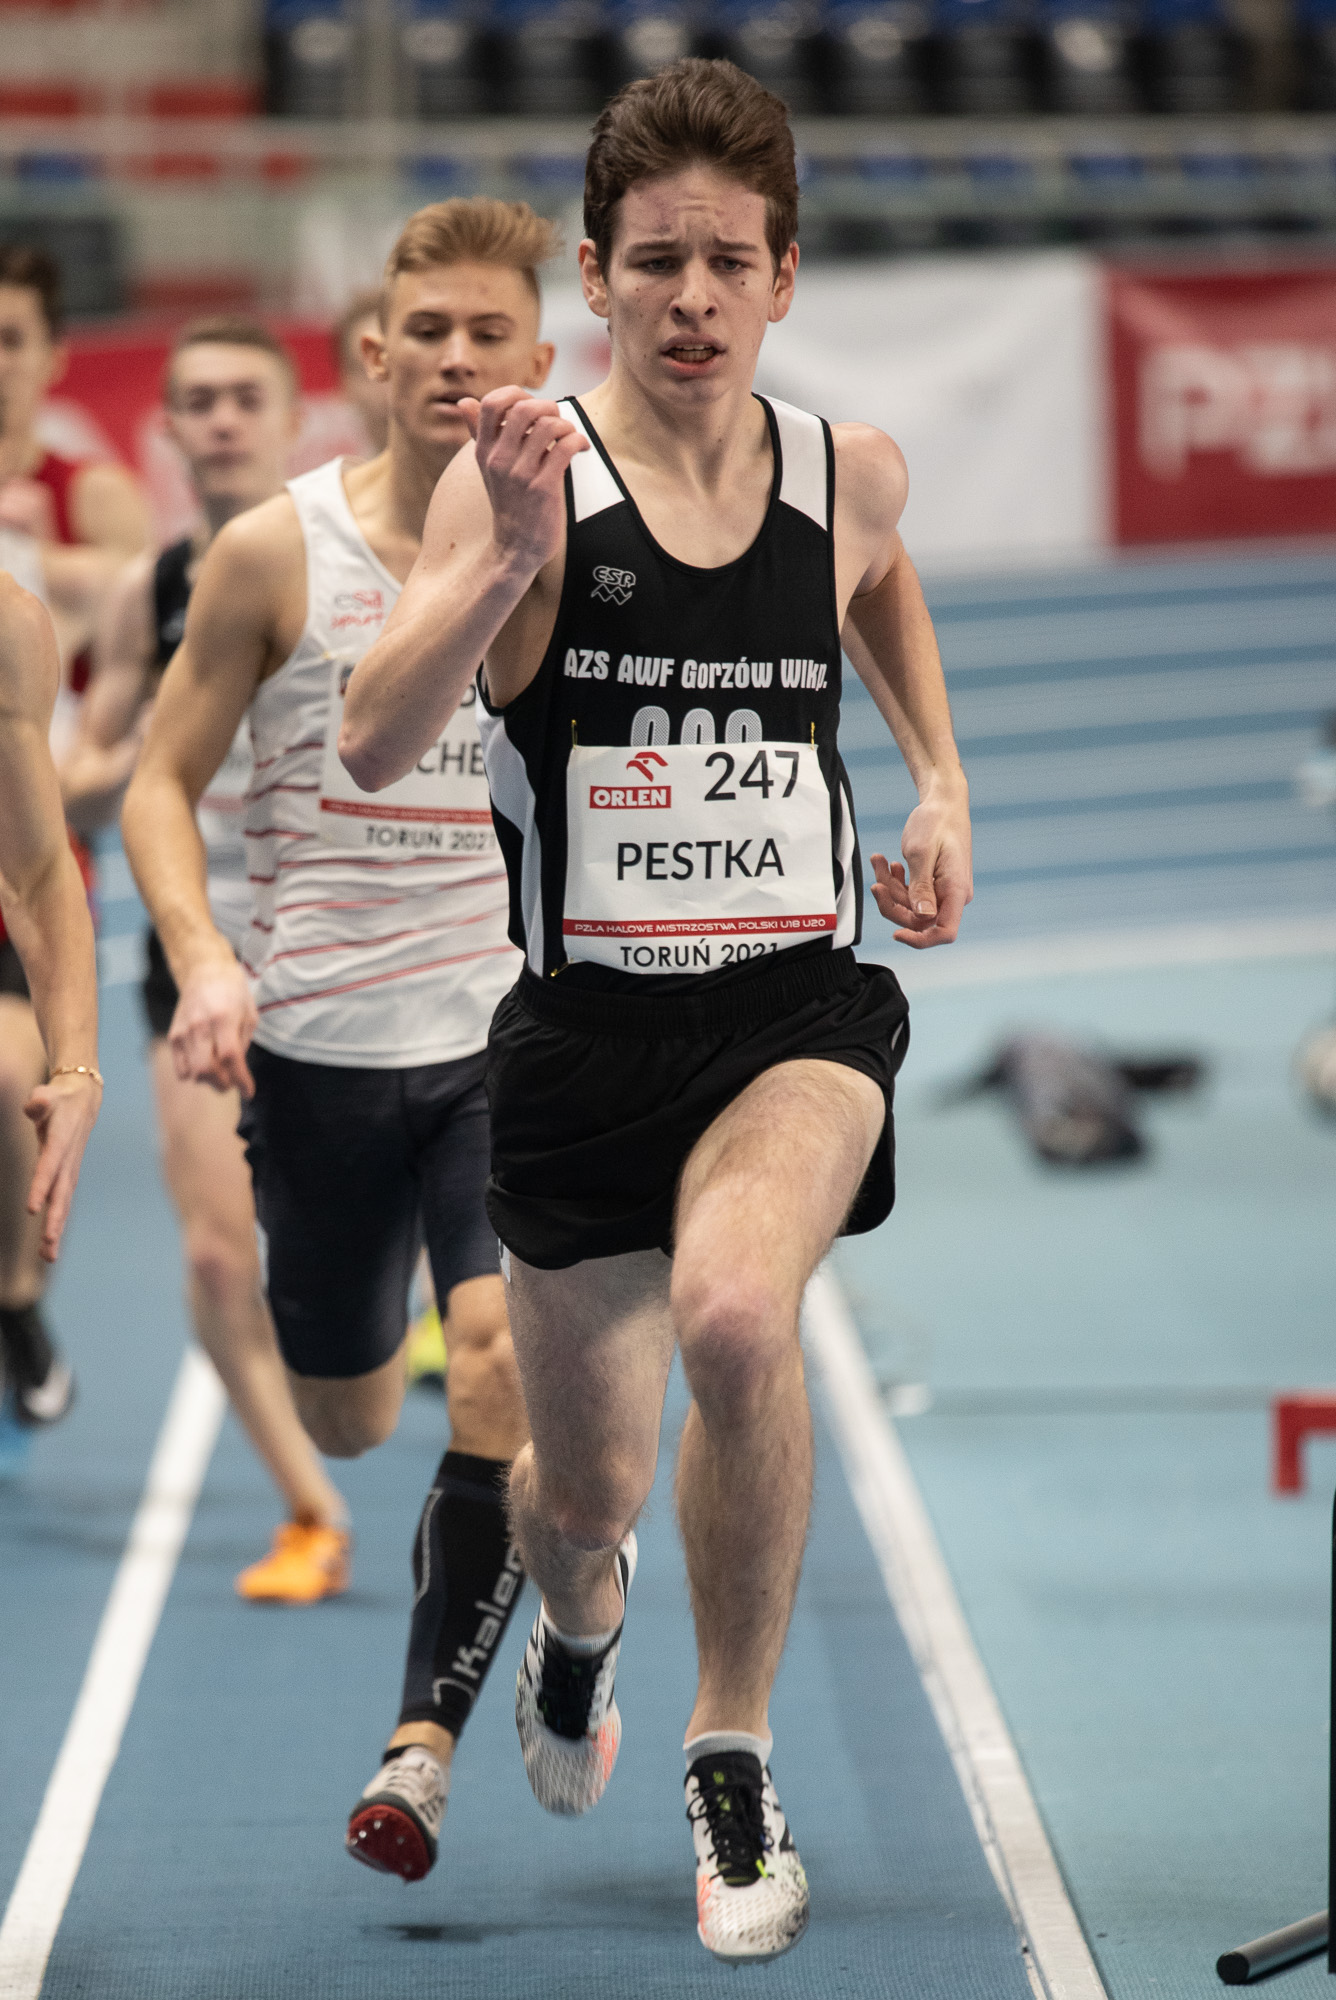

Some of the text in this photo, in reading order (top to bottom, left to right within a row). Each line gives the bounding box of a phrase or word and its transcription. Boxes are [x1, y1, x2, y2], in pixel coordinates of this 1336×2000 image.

[564, 648, 611, 681] AZS
[617, 654, 675, 687] AWF
[681, 656, 773, 688] Gorzów
[704, 749, 800, 802] 247
[593, 788, 667, 807] ORLEN
[616, 837, 785, 881] PESTKA
[574, 923, 604, 933] PZLA
[606, 924, 653, 933] HALOWE
[656, 922, 737, 933] MISTRZOSTWA
[738, 921, 778, 930] POLSKI
[802, 918, 826, 928] U20
[620, 938, 711, 967] TORUŃ
